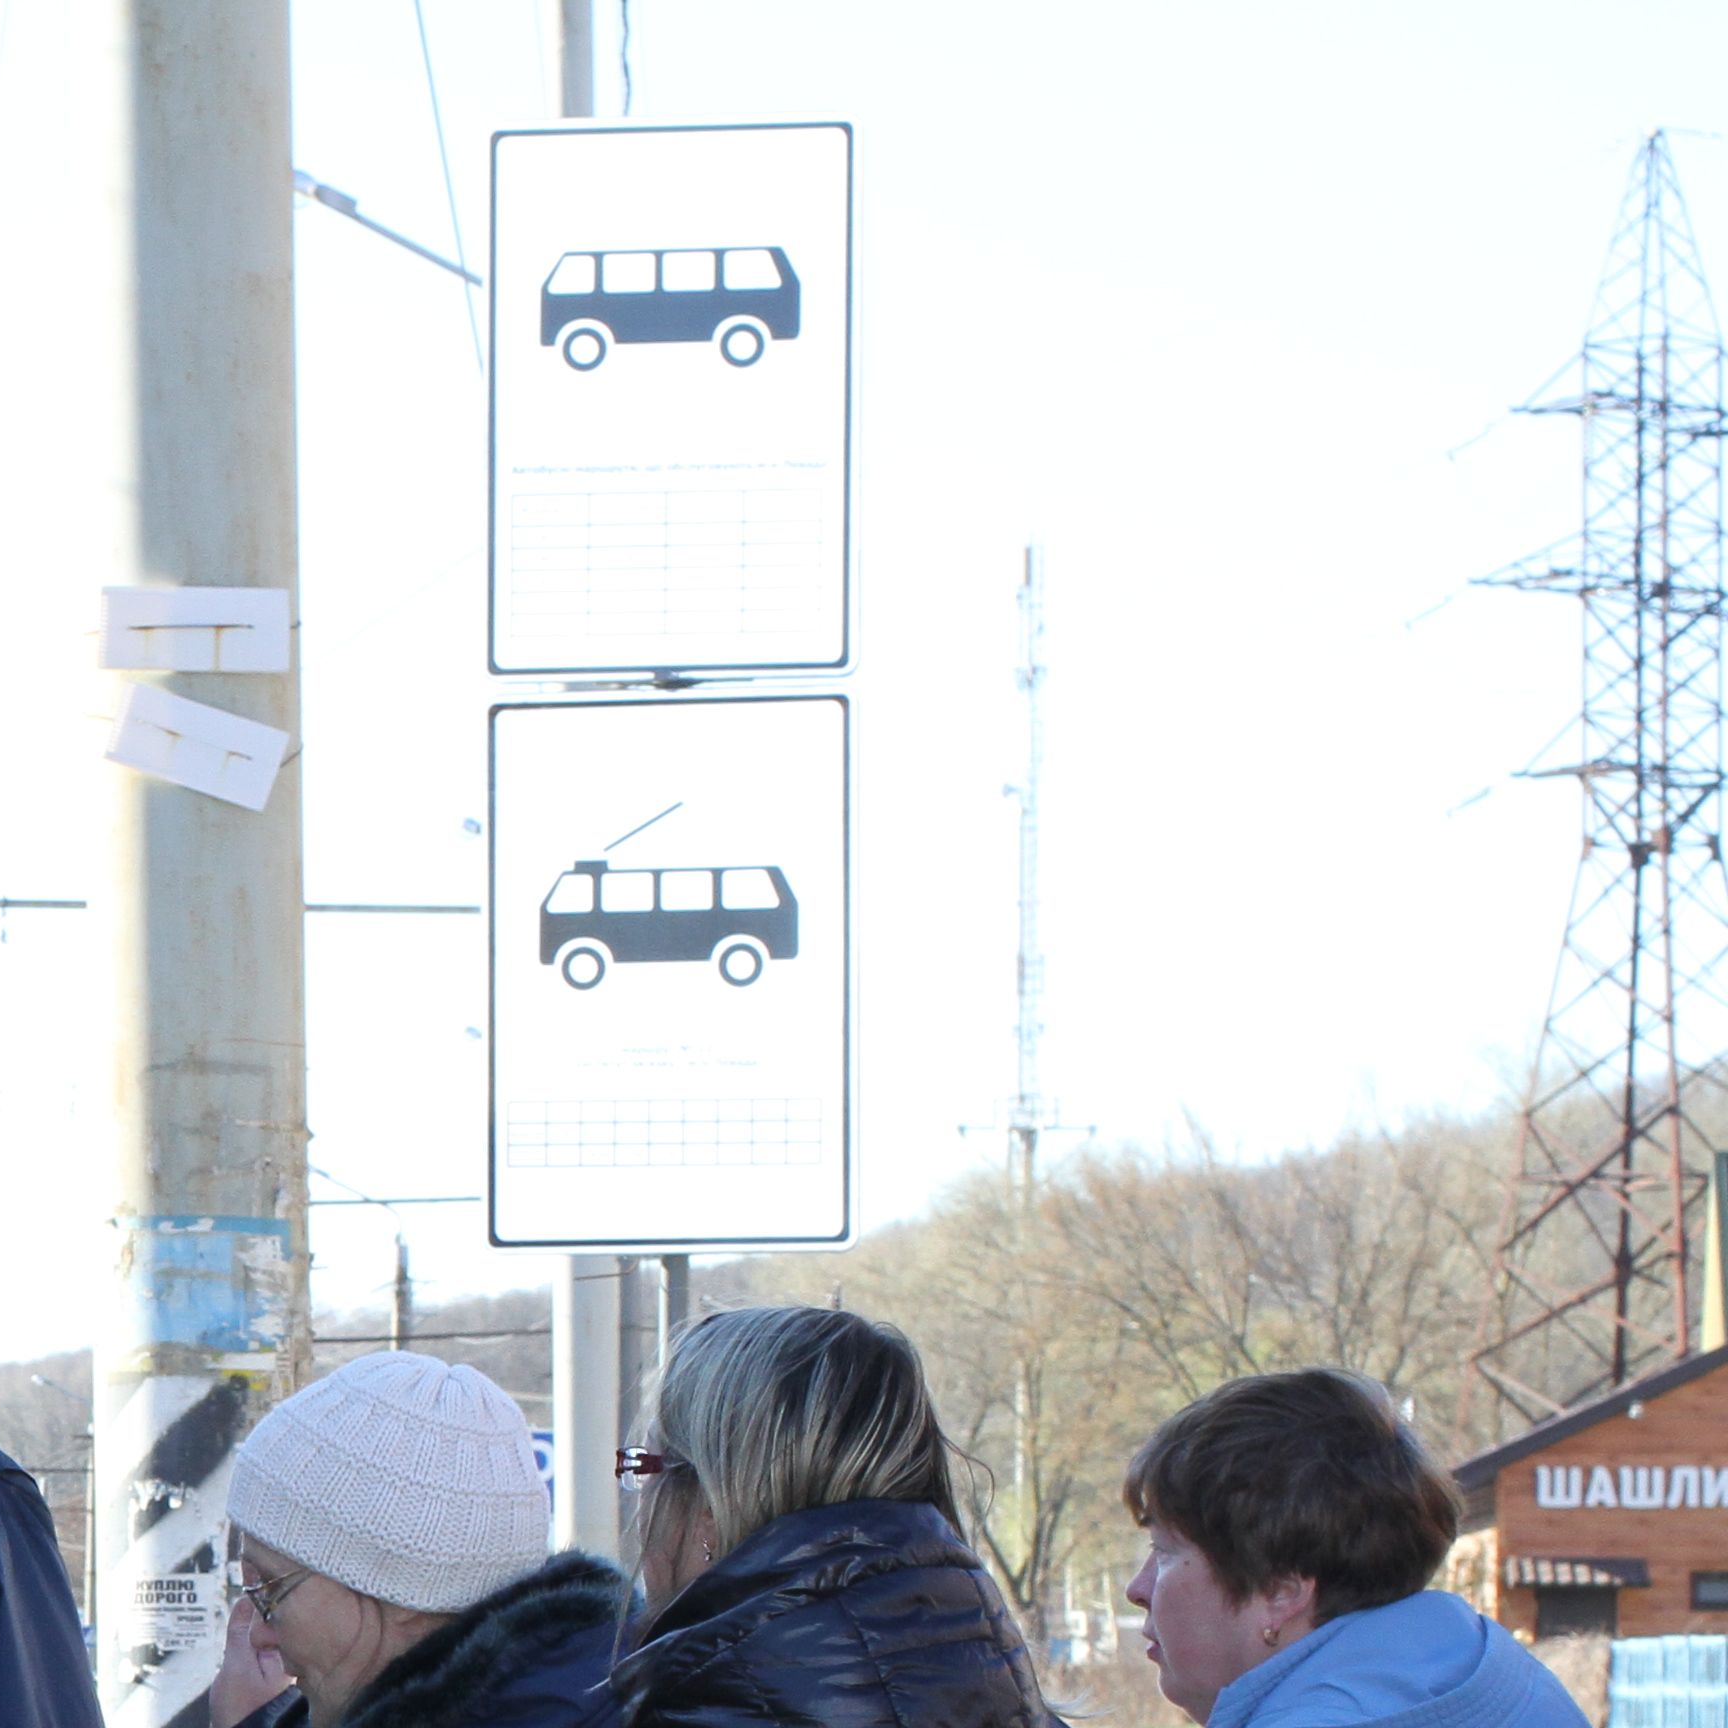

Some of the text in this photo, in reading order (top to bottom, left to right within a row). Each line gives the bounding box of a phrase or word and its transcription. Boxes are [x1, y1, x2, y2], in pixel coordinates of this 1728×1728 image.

[1536, 1465, 1728, 1508] ШАШЛИ
[135, 1579, 195, 1591] КУПЛЮ
[134, 1592, 198, 1604] ДОРОГО
